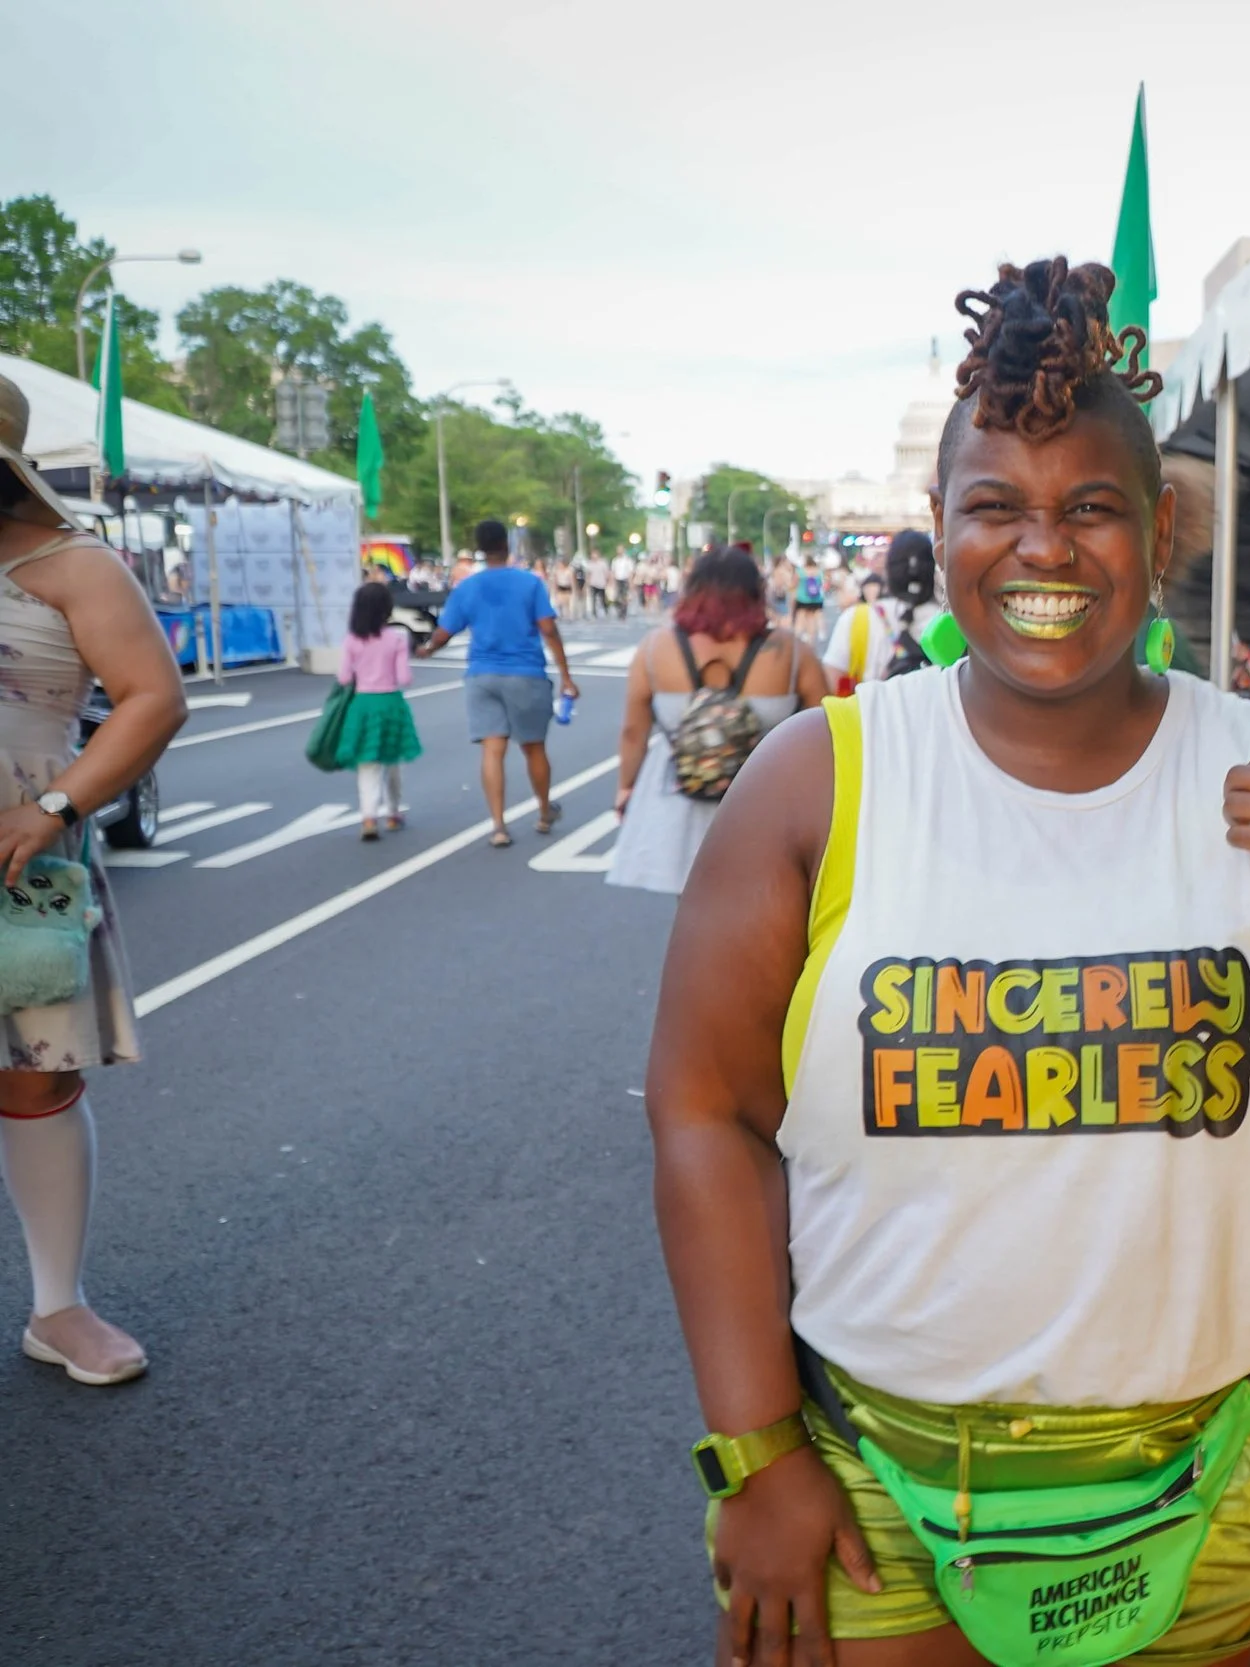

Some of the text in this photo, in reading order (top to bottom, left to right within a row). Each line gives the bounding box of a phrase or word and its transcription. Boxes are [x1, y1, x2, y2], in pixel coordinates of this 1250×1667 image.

[870, 959, 1247, 1035] SINCERELY
[872, 1038, 1248, 1131] FEARLESS
[1029, 1553, 1142, 1610] AMERICAN
[1029, 1571, 1150, 1635] EXCHANGE
[1037, 1605, 1142, 1656] PREPSTER
